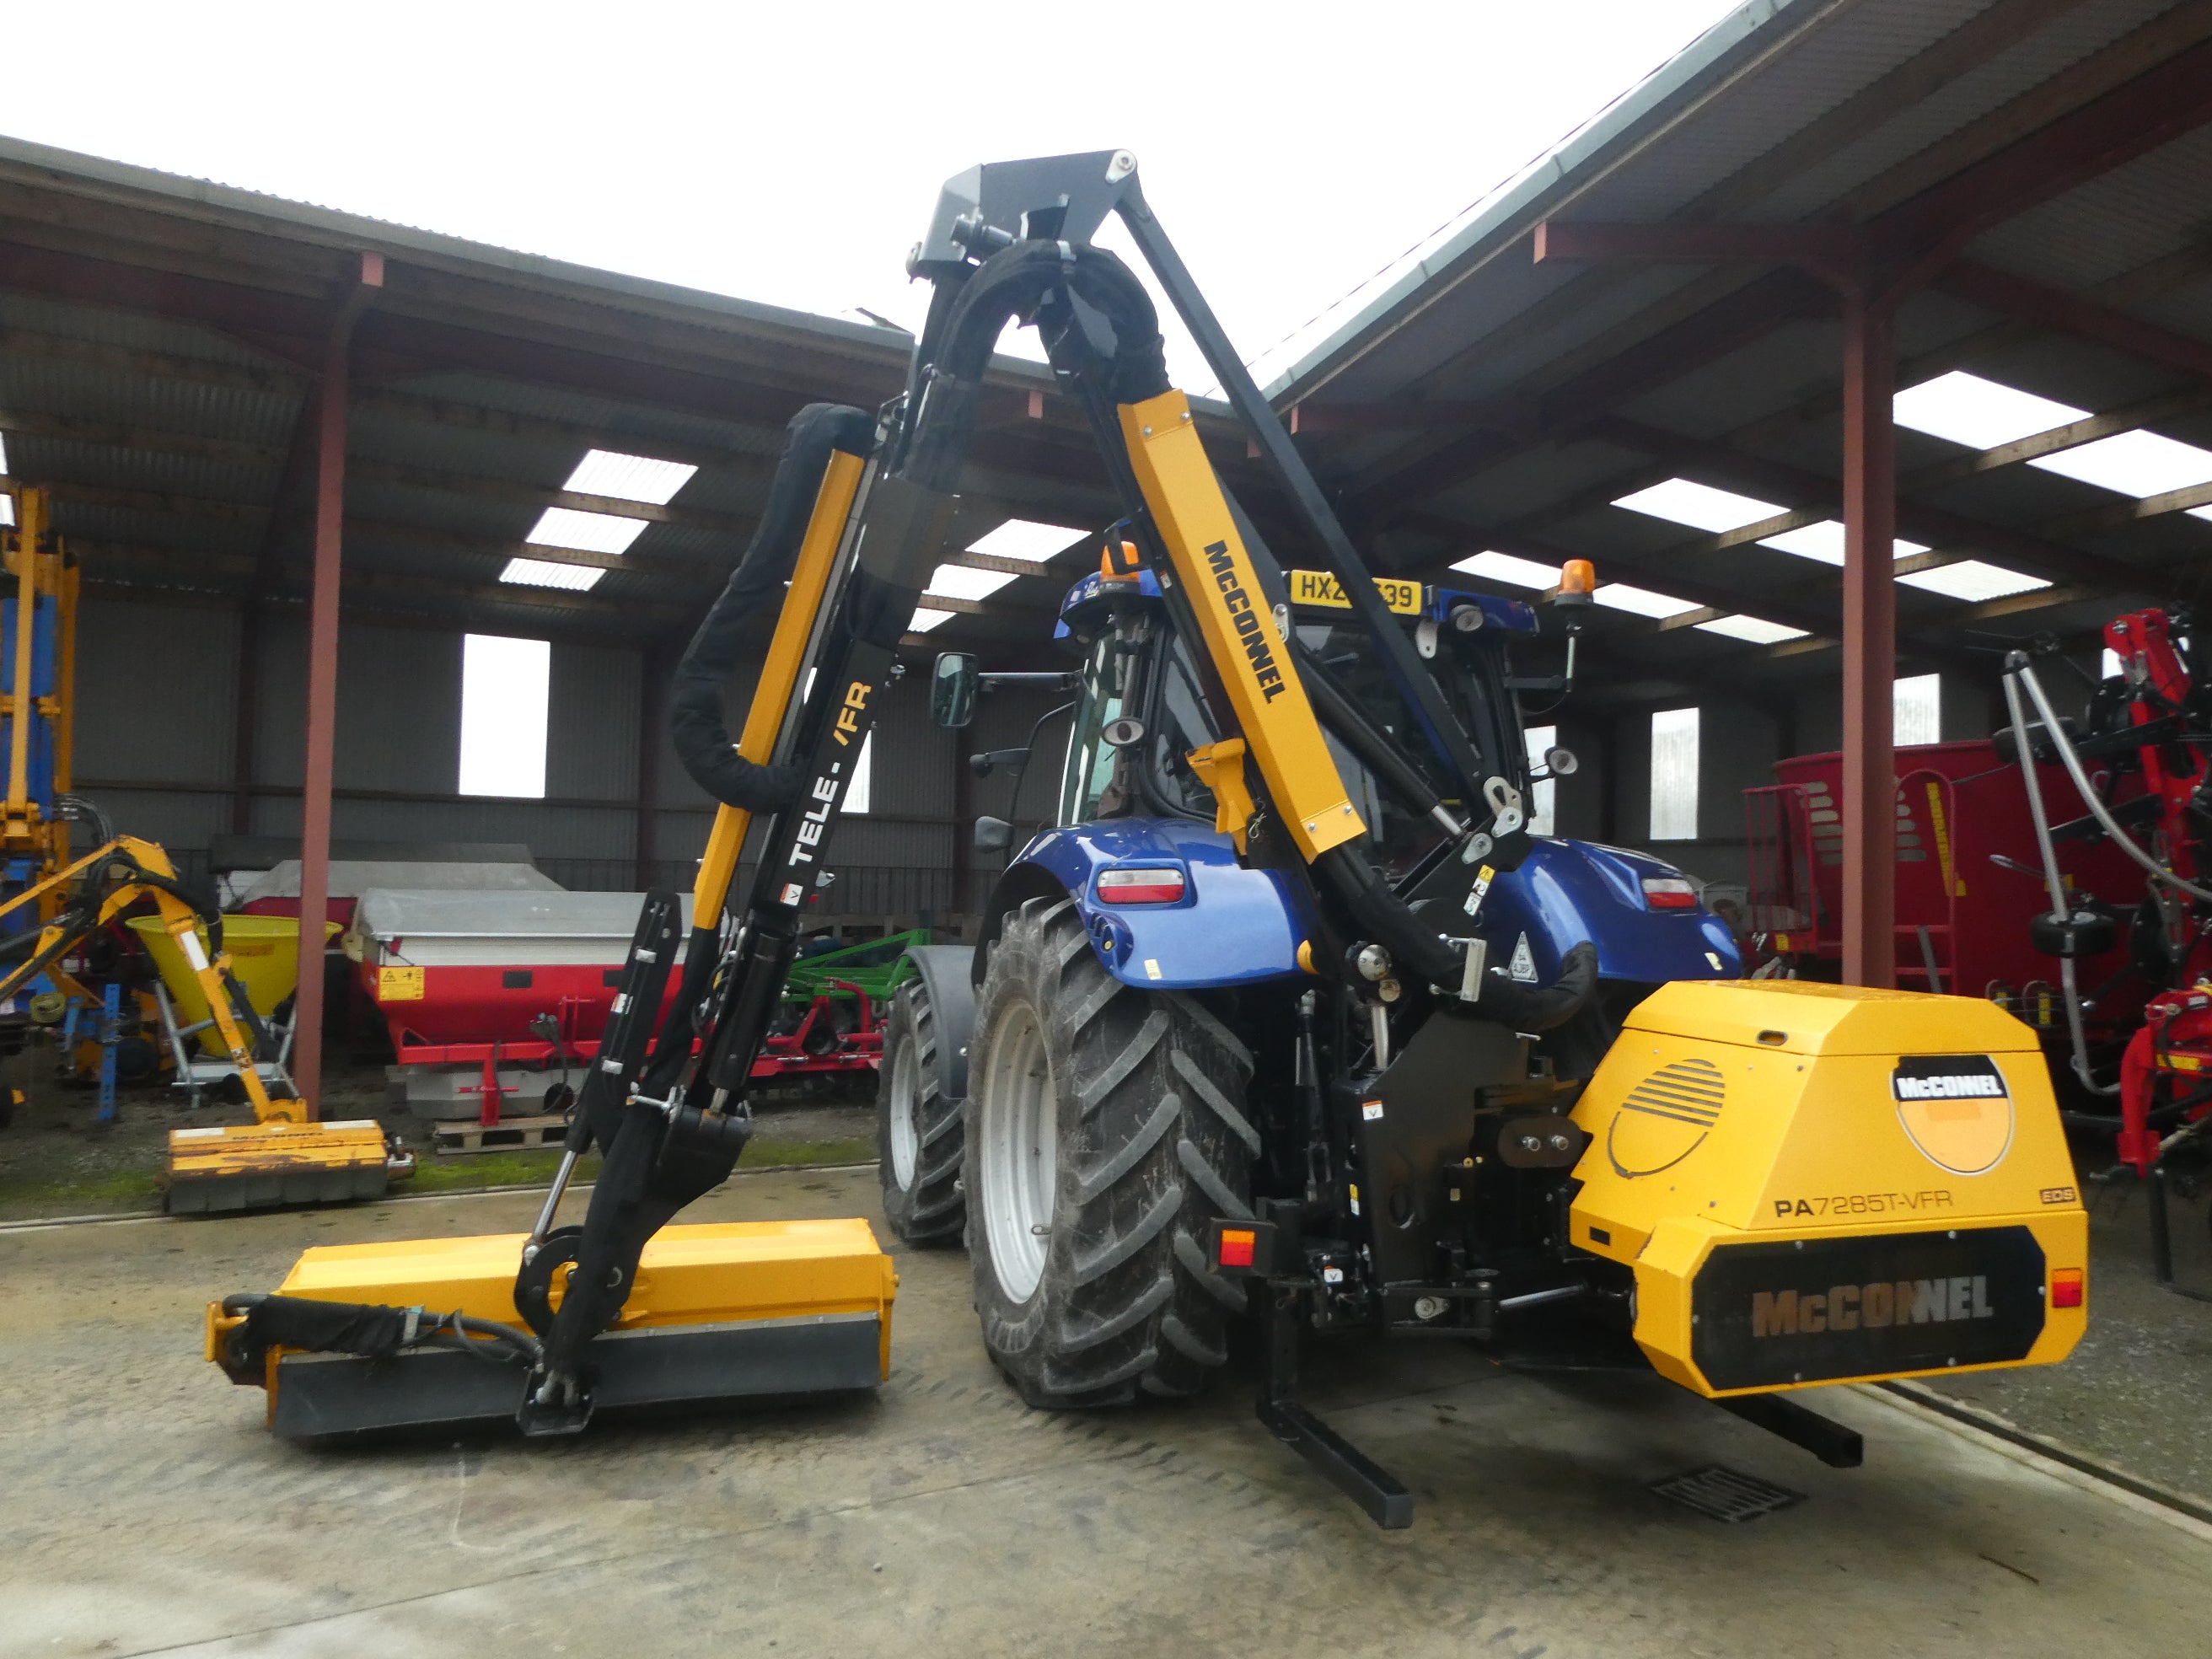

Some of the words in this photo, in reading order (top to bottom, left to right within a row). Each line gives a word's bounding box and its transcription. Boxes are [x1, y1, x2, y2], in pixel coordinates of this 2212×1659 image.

[1375, 583, 1413, 608] 39
[1204, 539, 1286, 705] McCONNEL
[1897, 1074, 2003, 1098] McCONNEL
[1774, 1189, 1954, 1217] PA7285T-VFR
[1752, 1275, 1994, 1338] McCONNEL
